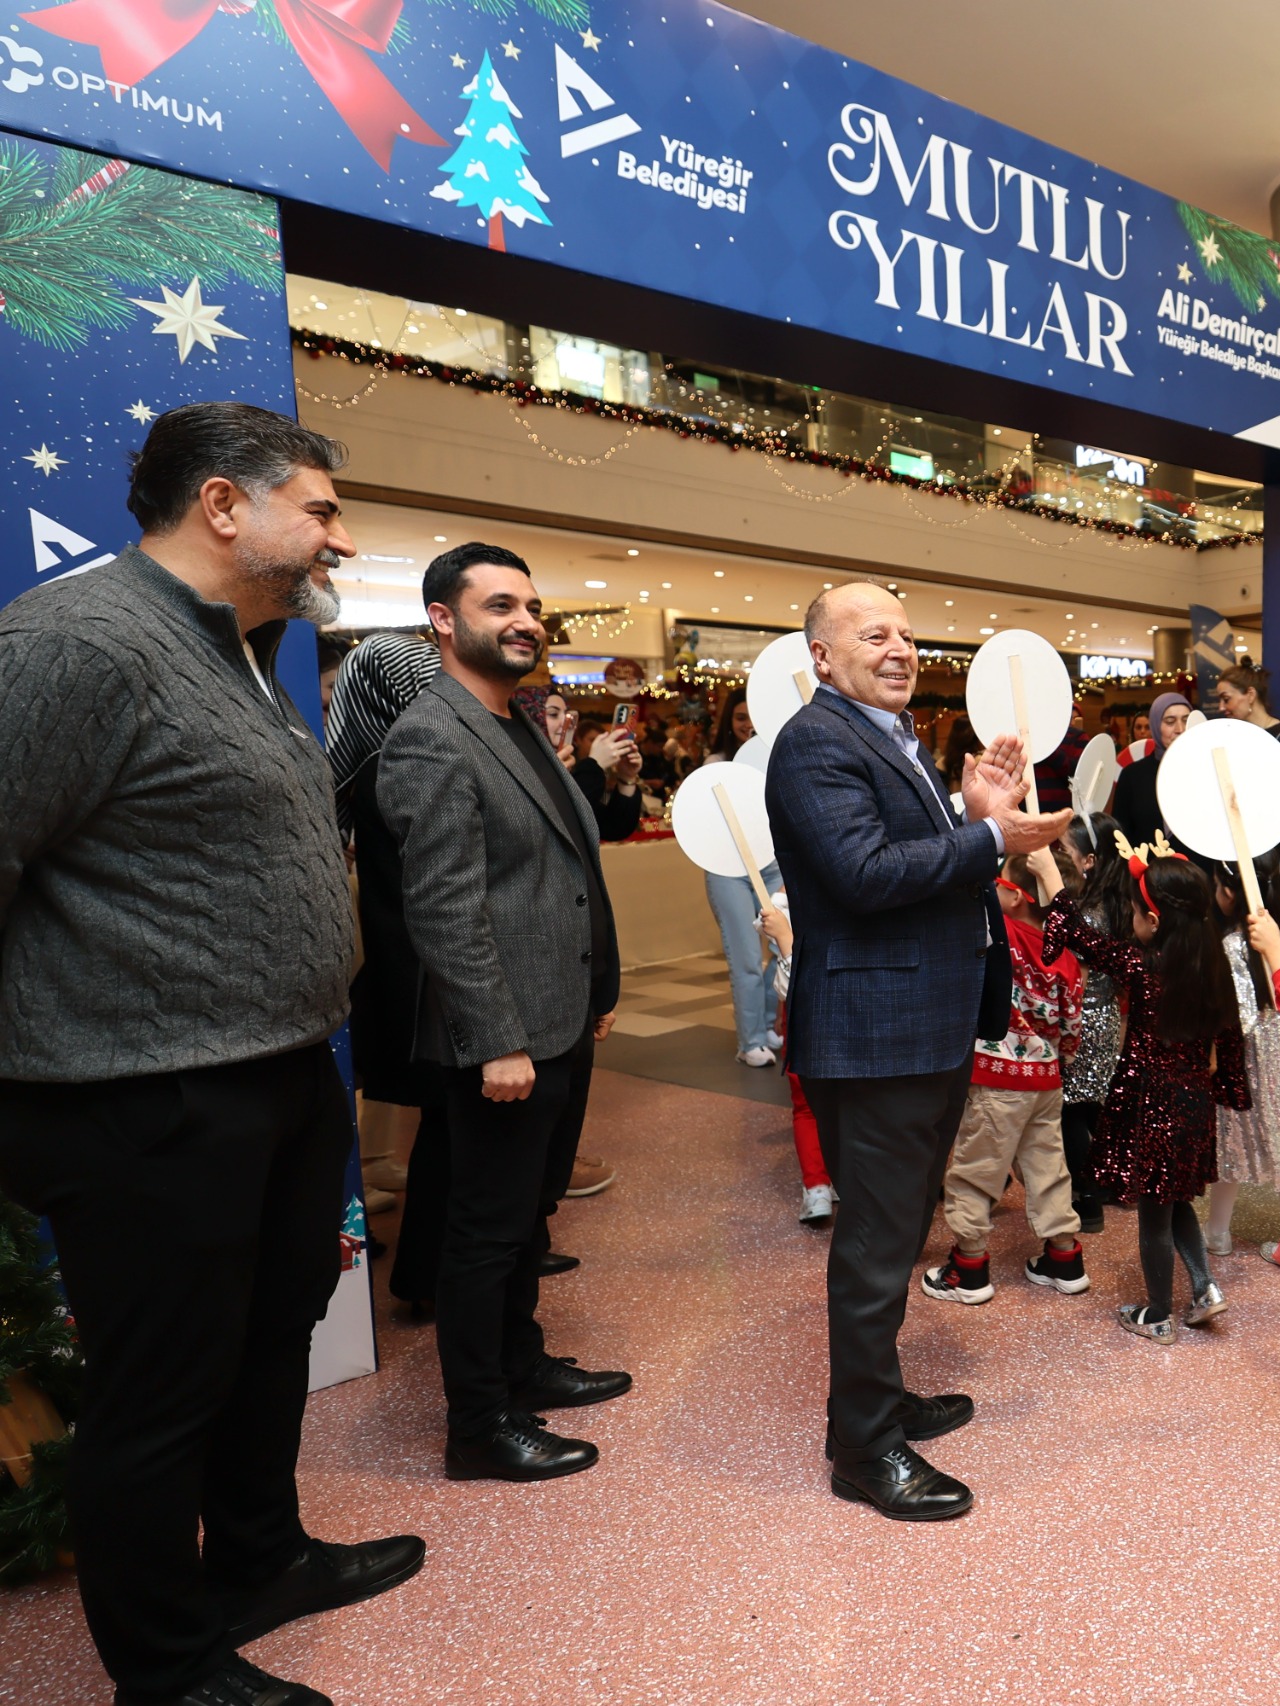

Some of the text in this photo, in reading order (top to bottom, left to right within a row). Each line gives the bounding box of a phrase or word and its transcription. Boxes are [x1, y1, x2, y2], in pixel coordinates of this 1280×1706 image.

[52, 66, 223, 132] OPTIMUM
[617, 150, 748, 214] Belediyesi
[660, 134, 753, 188] Yüreğir
[828, 102, 1132, 281] MUTLU
[828, 209, 1135, 377] YILLAR
[1157, 288, 1190, 326] Ali
[1157, 325, 1200, 356] Yüreğir
[1200, 339, 1248, 371] Belediye
